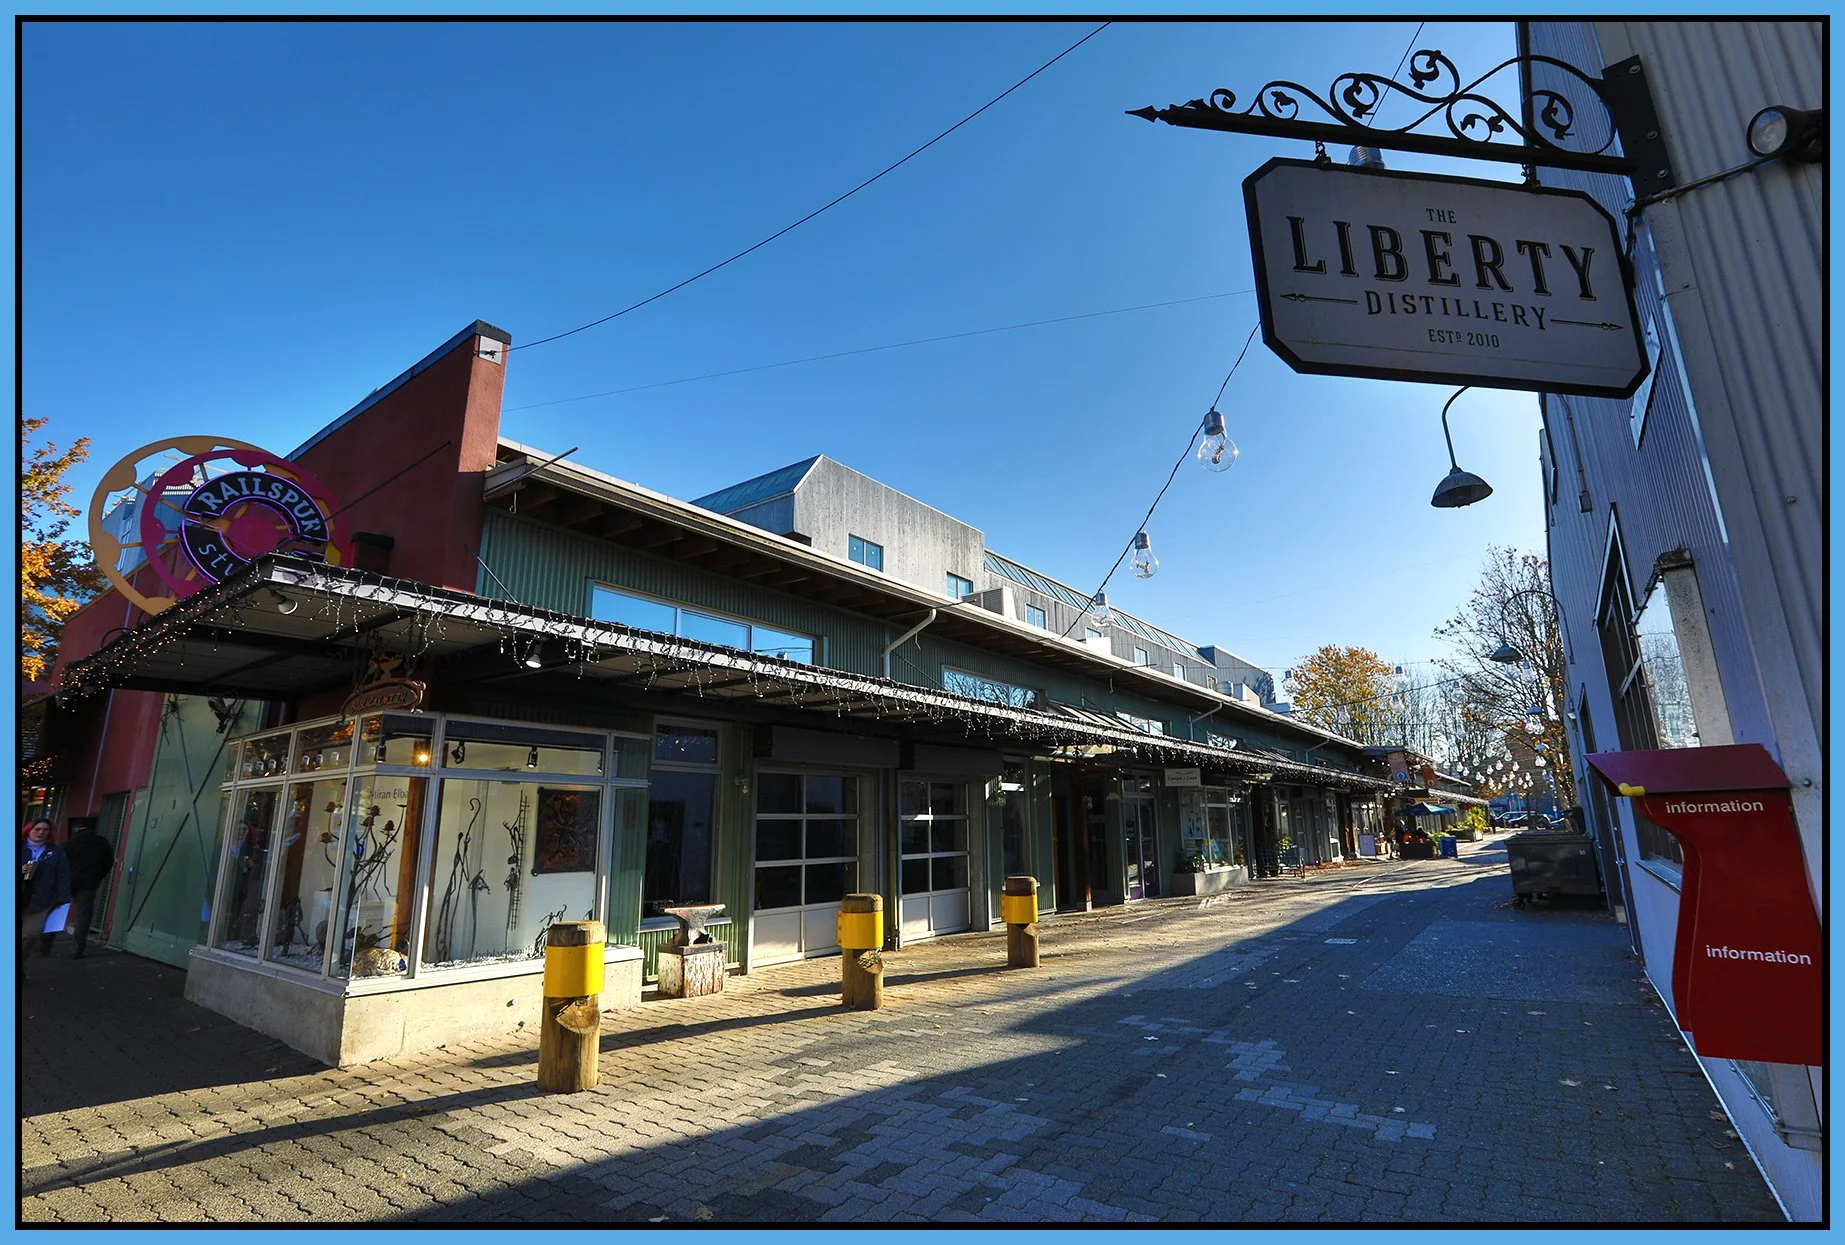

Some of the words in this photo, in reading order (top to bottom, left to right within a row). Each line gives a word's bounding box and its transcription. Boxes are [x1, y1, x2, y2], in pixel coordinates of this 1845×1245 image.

[1426, 207, 1457, 224] THE
[1285, 215, 1596, 301] LIBERTY
[1364, 290, 1546, 331] DISTILLERY
[1466, 331, 1500, 348] 2010
[197, 477, 321, 532] RAILSPUR
[1665, 800, 1764, 814] information
[1705, 944, 1812, 965] information
